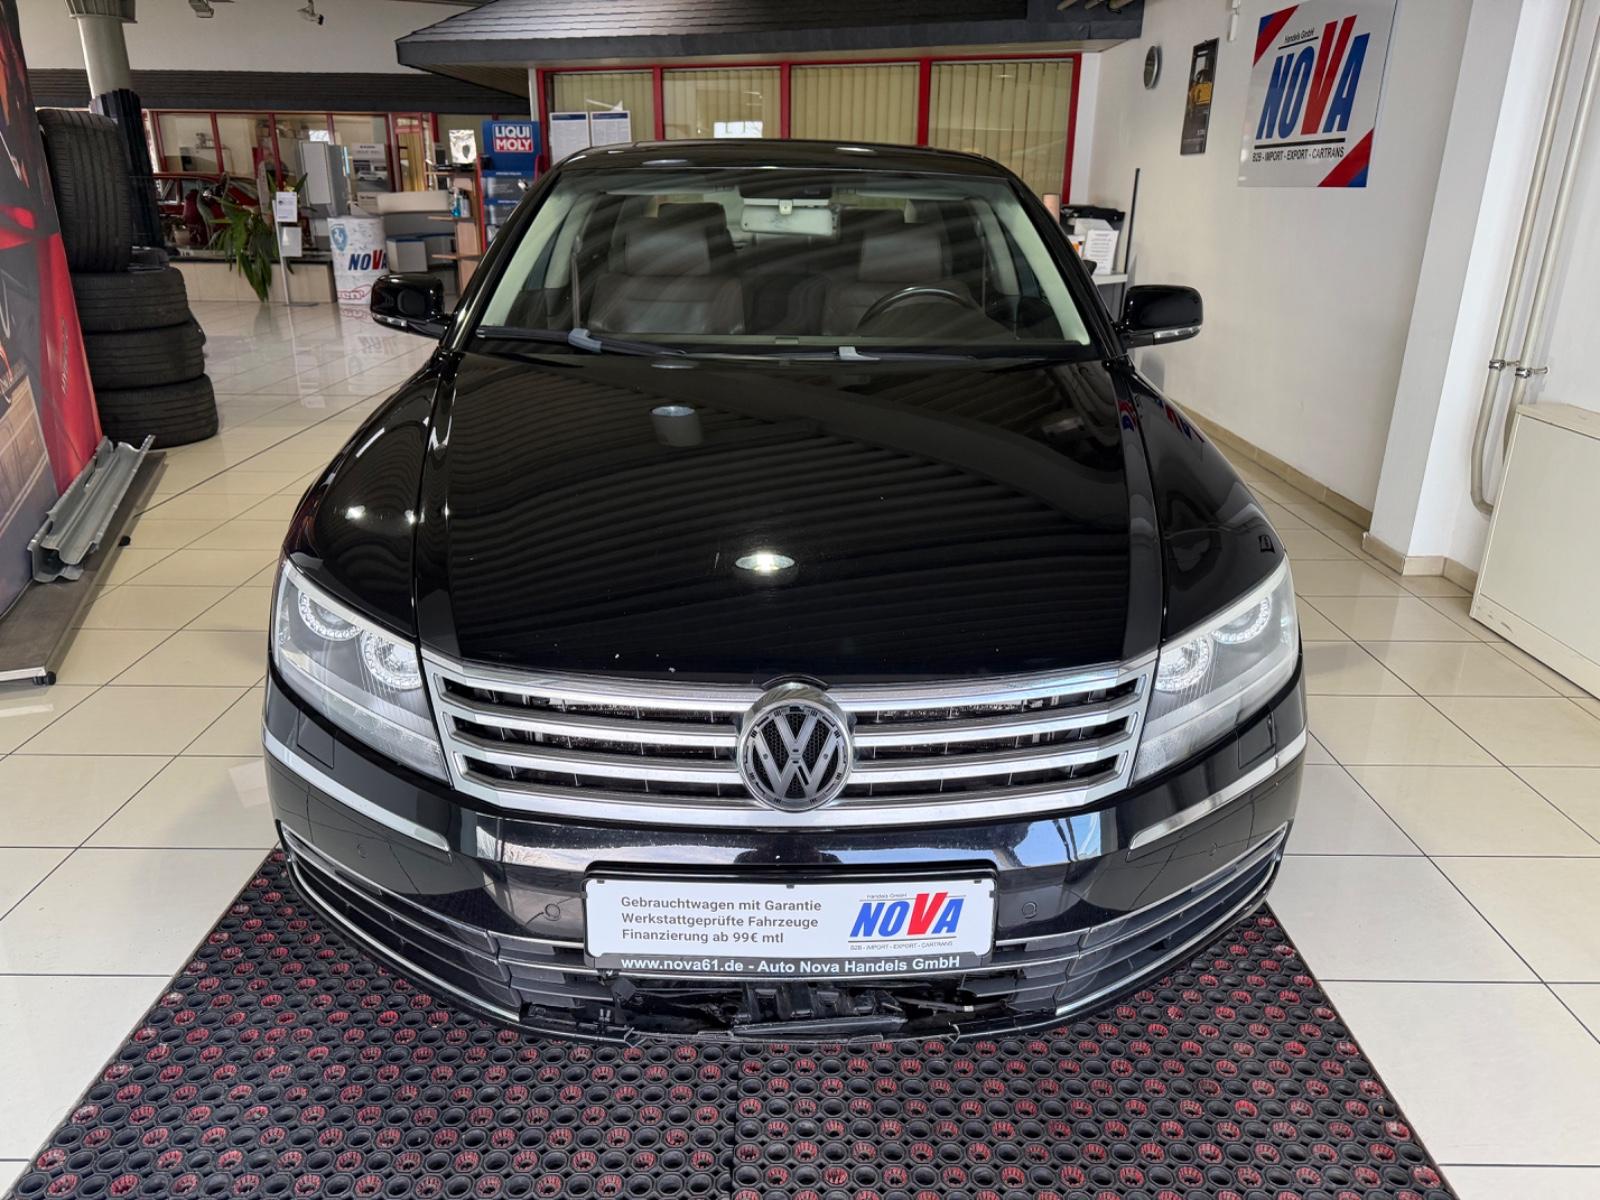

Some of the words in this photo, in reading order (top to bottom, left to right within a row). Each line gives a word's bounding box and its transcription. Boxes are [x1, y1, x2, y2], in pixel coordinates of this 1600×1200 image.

[1300, 26, 1315, 40] GmbH
[1255, 14, 1371, 140] NOVA
[494, 125, 531, 138] LIQUI
[495, 138, 533, 152] MOLY
[1264, 150, 1284, 162] IMPORT
[1286, 148, 1309, 160] EXPORT
[1311, 146, 1345, 159] CARTRANS
[621, 896, 735, 913] Gebrauchtwagen
[738, 899, 761, 911] mit
[764, 899, 822, 911] Garantie
[621, 912, 744, 928] Werkstattgeprüfte
[748, 915, 819, 930] Fahrzeuge
[849, 891, 964, 938] NOVA
[622, 928, 709, 944] Finanzierung
[712, 931, 729, 942] ab
[733, 932, 758, 943] 99€
[762, 932, 784, 943] mtl
[893, 942, 918, 950] EXPORT
[620, 958, 744, 972] www.nova61.de
[757, 960, 796, 973] Auto
[799, 960, 840, 973] Nova
[844, 960, 908, 973] Handels
[912, 955, 960, 969] GmbH
